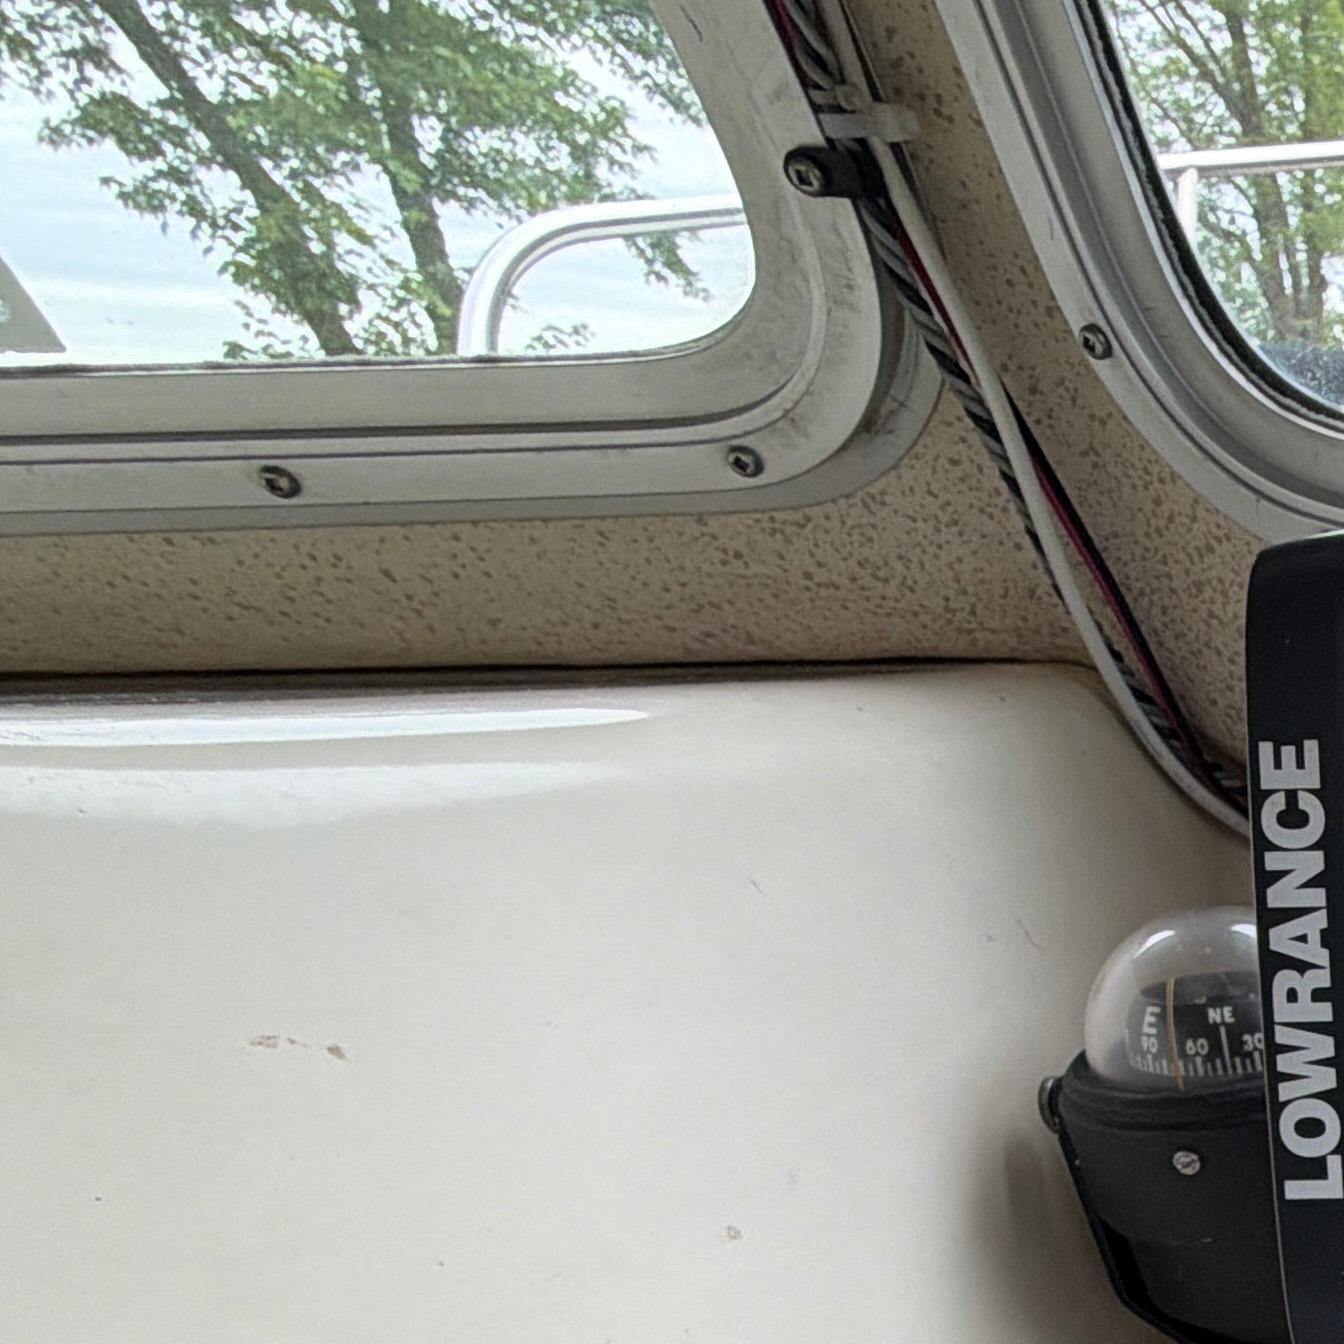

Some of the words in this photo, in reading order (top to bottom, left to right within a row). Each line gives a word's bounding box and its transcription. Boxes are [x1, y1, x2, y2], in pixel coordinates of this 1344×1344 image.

[1258, 739, 1344, 1200] LOWRANCE
[1142, 1006, 1161, 1035] E
[1208, 1006, 1235, 1024] NE
[1140, 1036, 1158, 1053] 90
[1186, 1038, 1208, 1056] 60
[1243, 1033, 1264, 1051] 30
